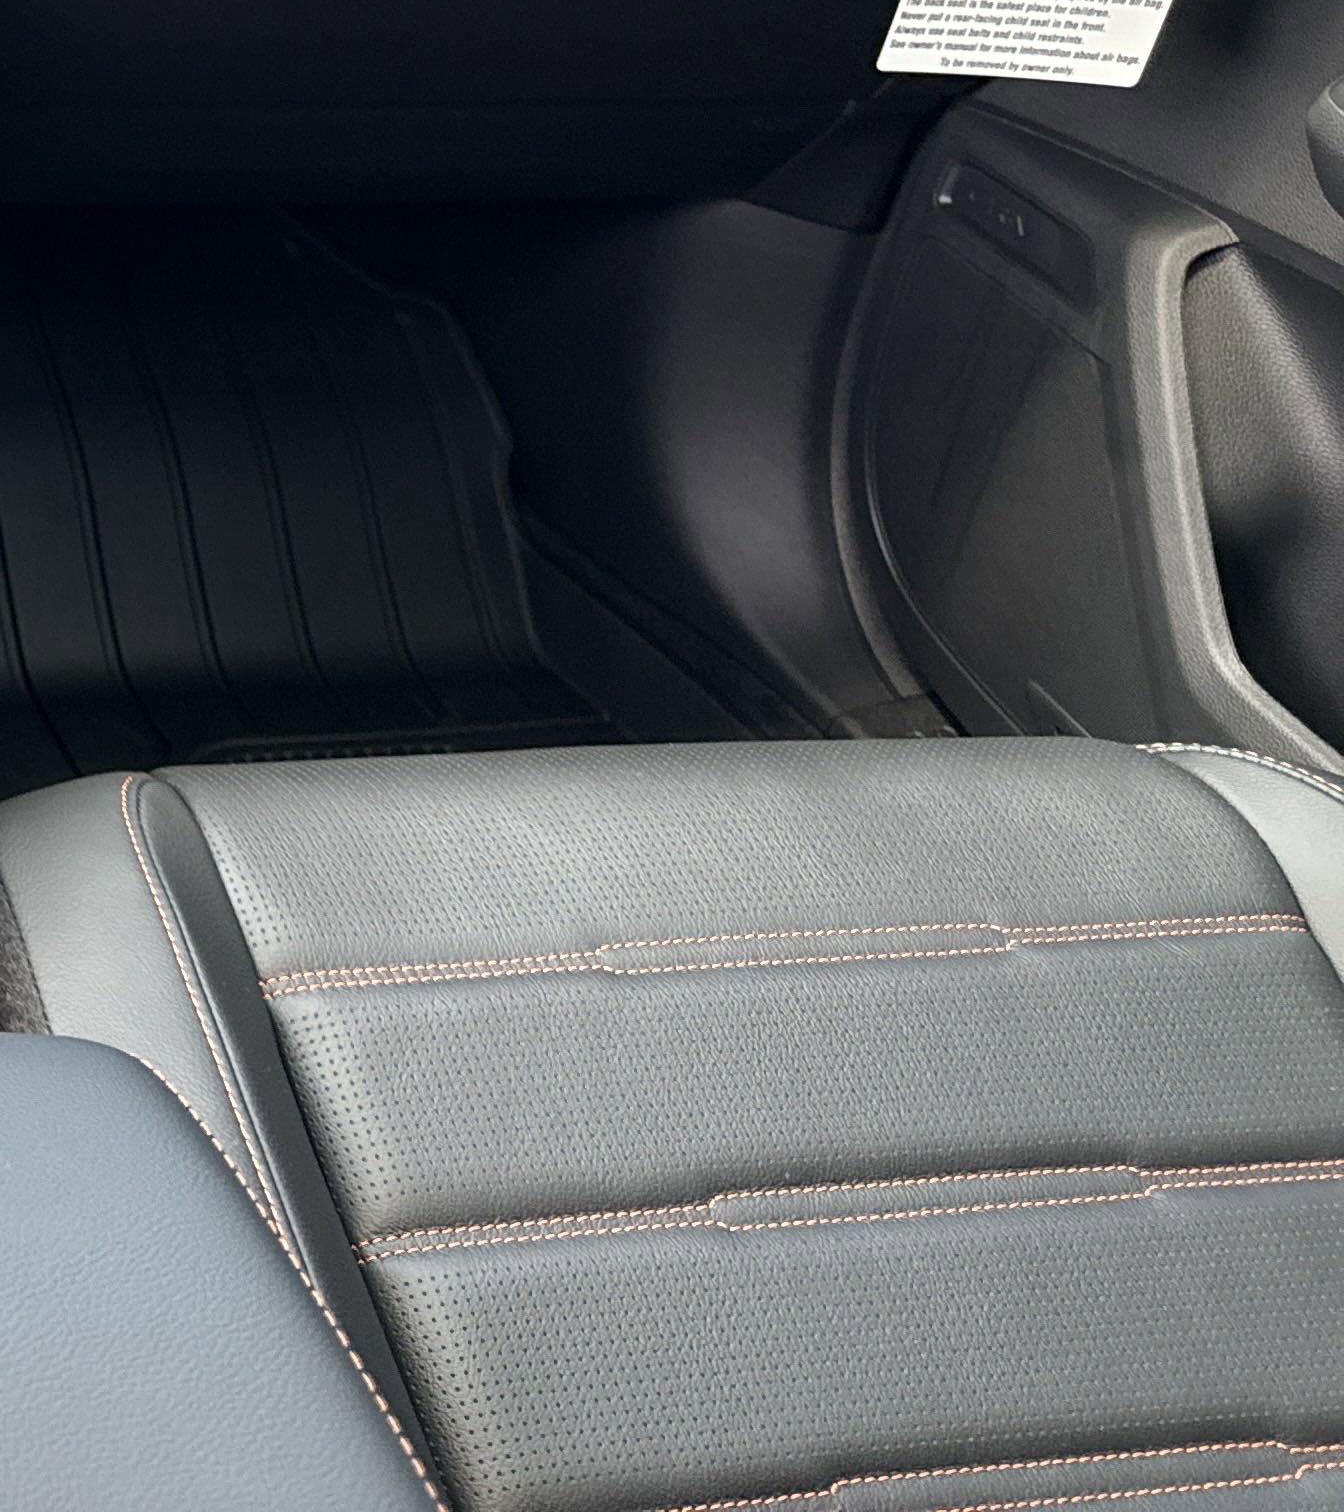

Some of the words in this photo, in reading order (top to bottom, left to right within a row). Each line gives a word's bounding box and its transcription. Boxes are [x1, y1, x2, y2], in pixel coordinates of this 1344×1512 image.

[969, 0, 977, 8] is
[980, 0, 993, 9] the
[996, 0, 1024, 10] safest
[1025, 2, 1051, 13] place
[1054, 4, 1067, 14] for
[1069, 6, 1111, 18] children.
[1005, 15, 1028, 26] child
[1030, 17, 1050, 27] seat
[1053, 18, 1062, 29] in
[1064, 19, 1078, 30] the
[993, 29, 1010, 39] and
[1012, 30, 1036, 40] child
[944, 41, 977, 51] manual
[980, 43, 992, 52] for
[993, 45, 1017, 53] more
[1019, 45, 1071, 58] information
[1073, 49, 1100, 60] about
[1101, 50, 1114, 62] air
[940, 57, 950, 66] To
[952, 58, 963, 68] be
[966, 60, 1010, 70] removed
[1010, 61, 1019, 72] by
